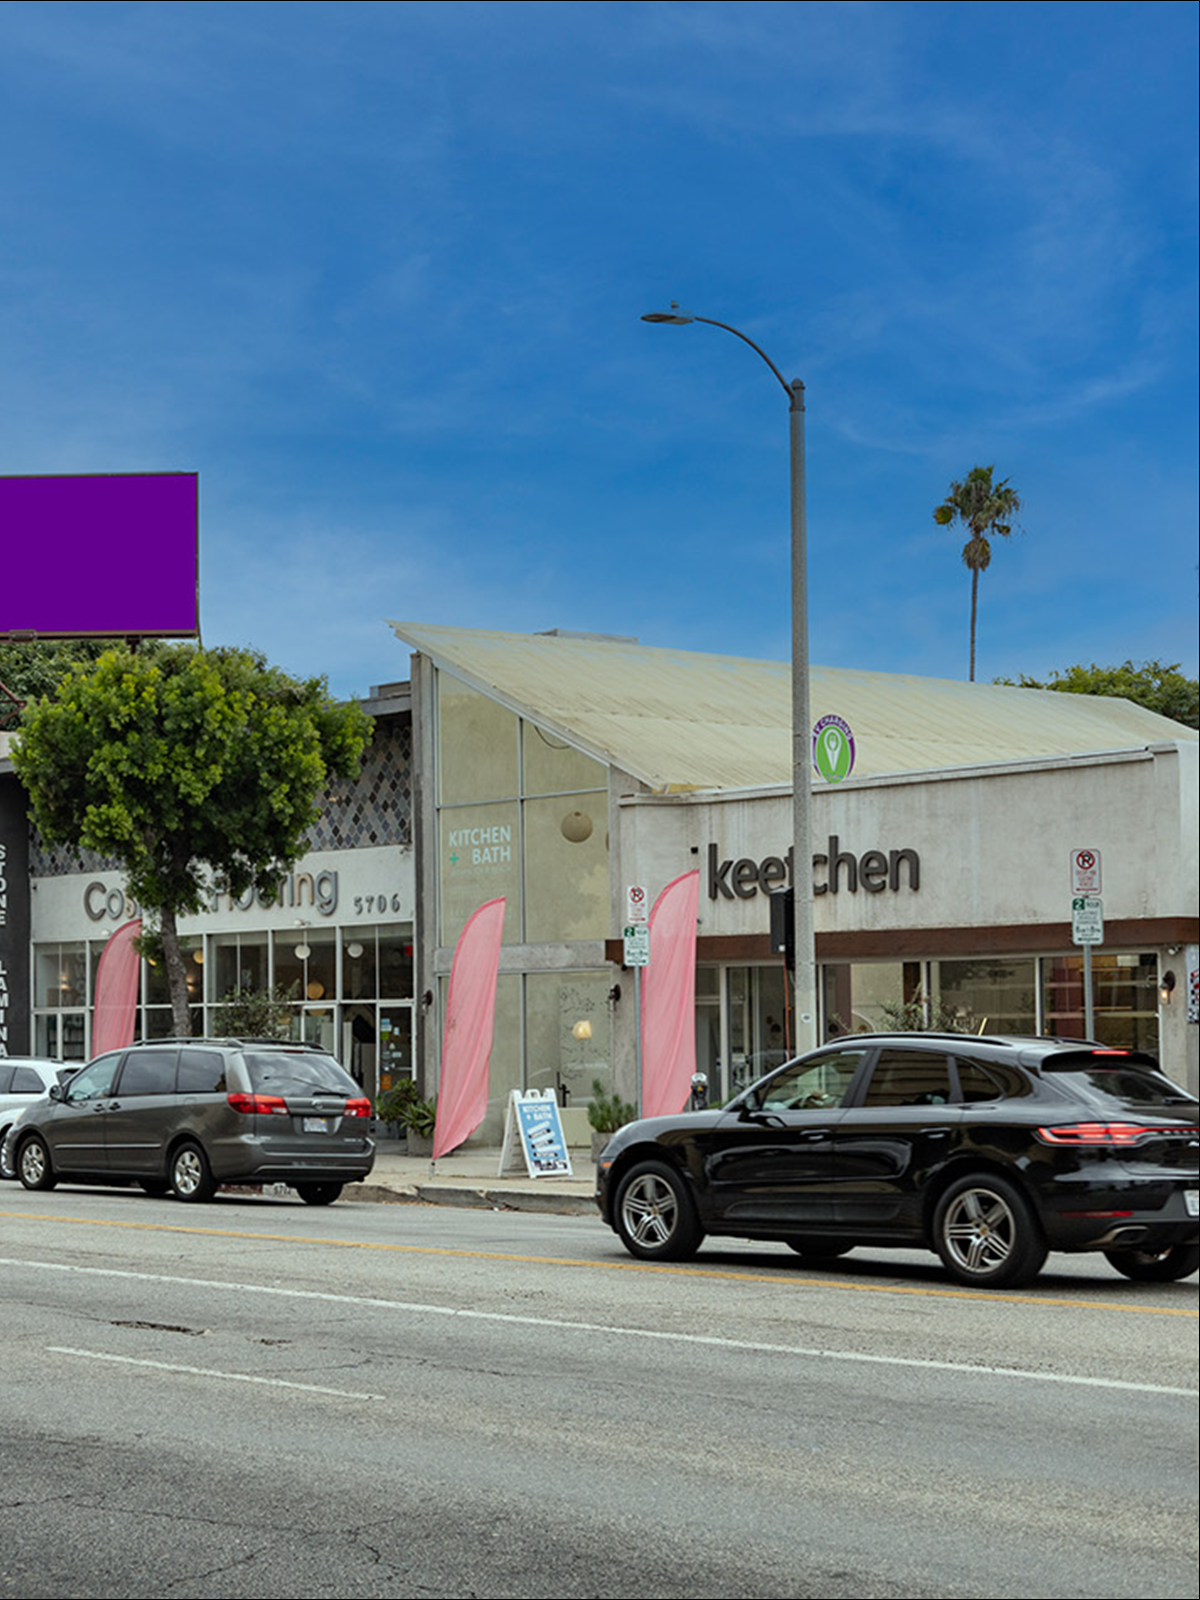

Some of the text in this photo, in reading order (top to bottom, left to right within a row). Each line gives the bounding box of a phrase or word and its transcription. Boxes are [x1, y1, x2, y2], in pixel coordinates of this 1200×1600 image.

[820, 716, 853, 740] CHARGING
[449, 825, 511, 847] KITCHEN
[473, 846, 511, 865] BATH
[354, 893, 400, 915] 5706
